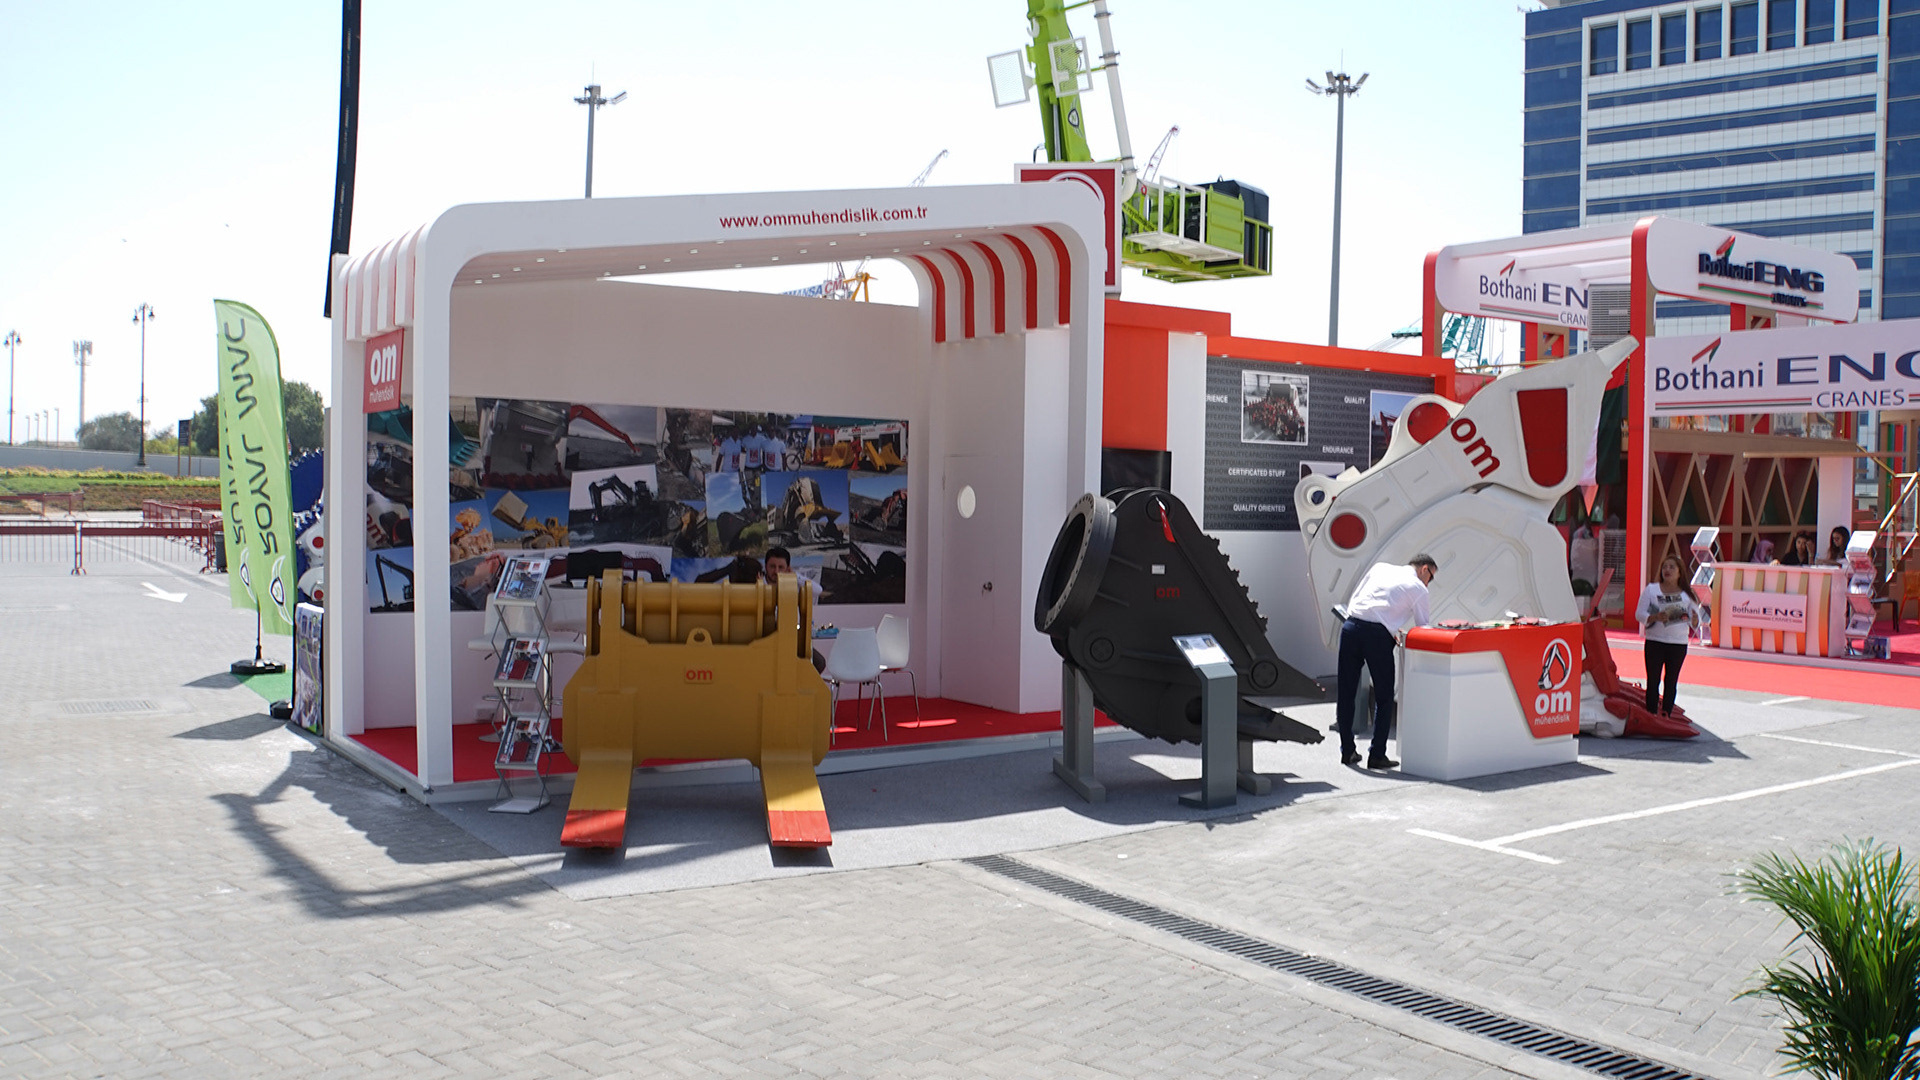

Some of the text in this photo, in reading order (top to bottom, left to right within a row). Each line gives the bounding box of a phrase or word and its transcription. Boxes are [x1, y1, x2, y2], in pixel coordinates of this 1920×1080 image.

[719, 205, 928, 229] www.ommuhendislik.com.tr
[1698, 252, 1824, 292] Bothani ENG
[1480, 274, 1588, 309] Bothani EN
[1560, 312, 1586, 326] CRAN
[370, 344, 397, 386] om
[1655, 361, 1764, 391] Bothani
[1344, 395, 1366, 405] QUALITY
[1816, 388, 1905, 408] CRANES
[1322, 445, 1354, 455] ENDURANCE
[1451, 418, 1500, 479] om
[1228, 467, 1286, 478] CERTIFICATED STUFF
[1233, 503, 1286, 513] QUALITY ORIENTED
[1156, 587, 1180, 598] om
[1732, 605, 1803, 619] Bothani ENG
[686, 669, 713, 680] om
[1535, 690, 1572, 715] om
